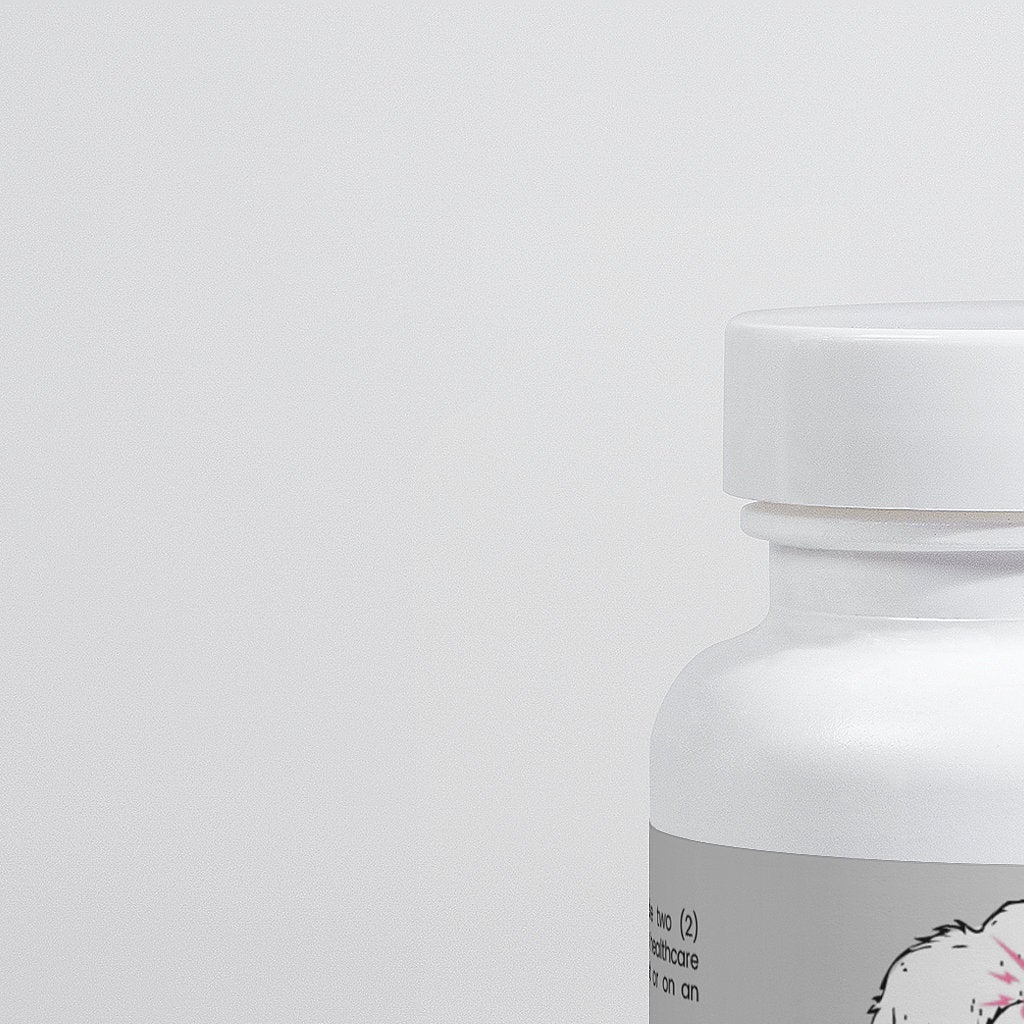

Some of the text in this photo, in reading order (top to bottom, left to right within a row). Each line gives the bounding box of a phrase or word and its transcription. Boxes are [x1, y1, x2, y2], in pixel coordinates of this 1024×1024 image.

[656, 905, 672, 931] two
[680, 908, 698, 943] (2)
[662, 976, 675, 996] on
[681, 982, 699, 1002] an
